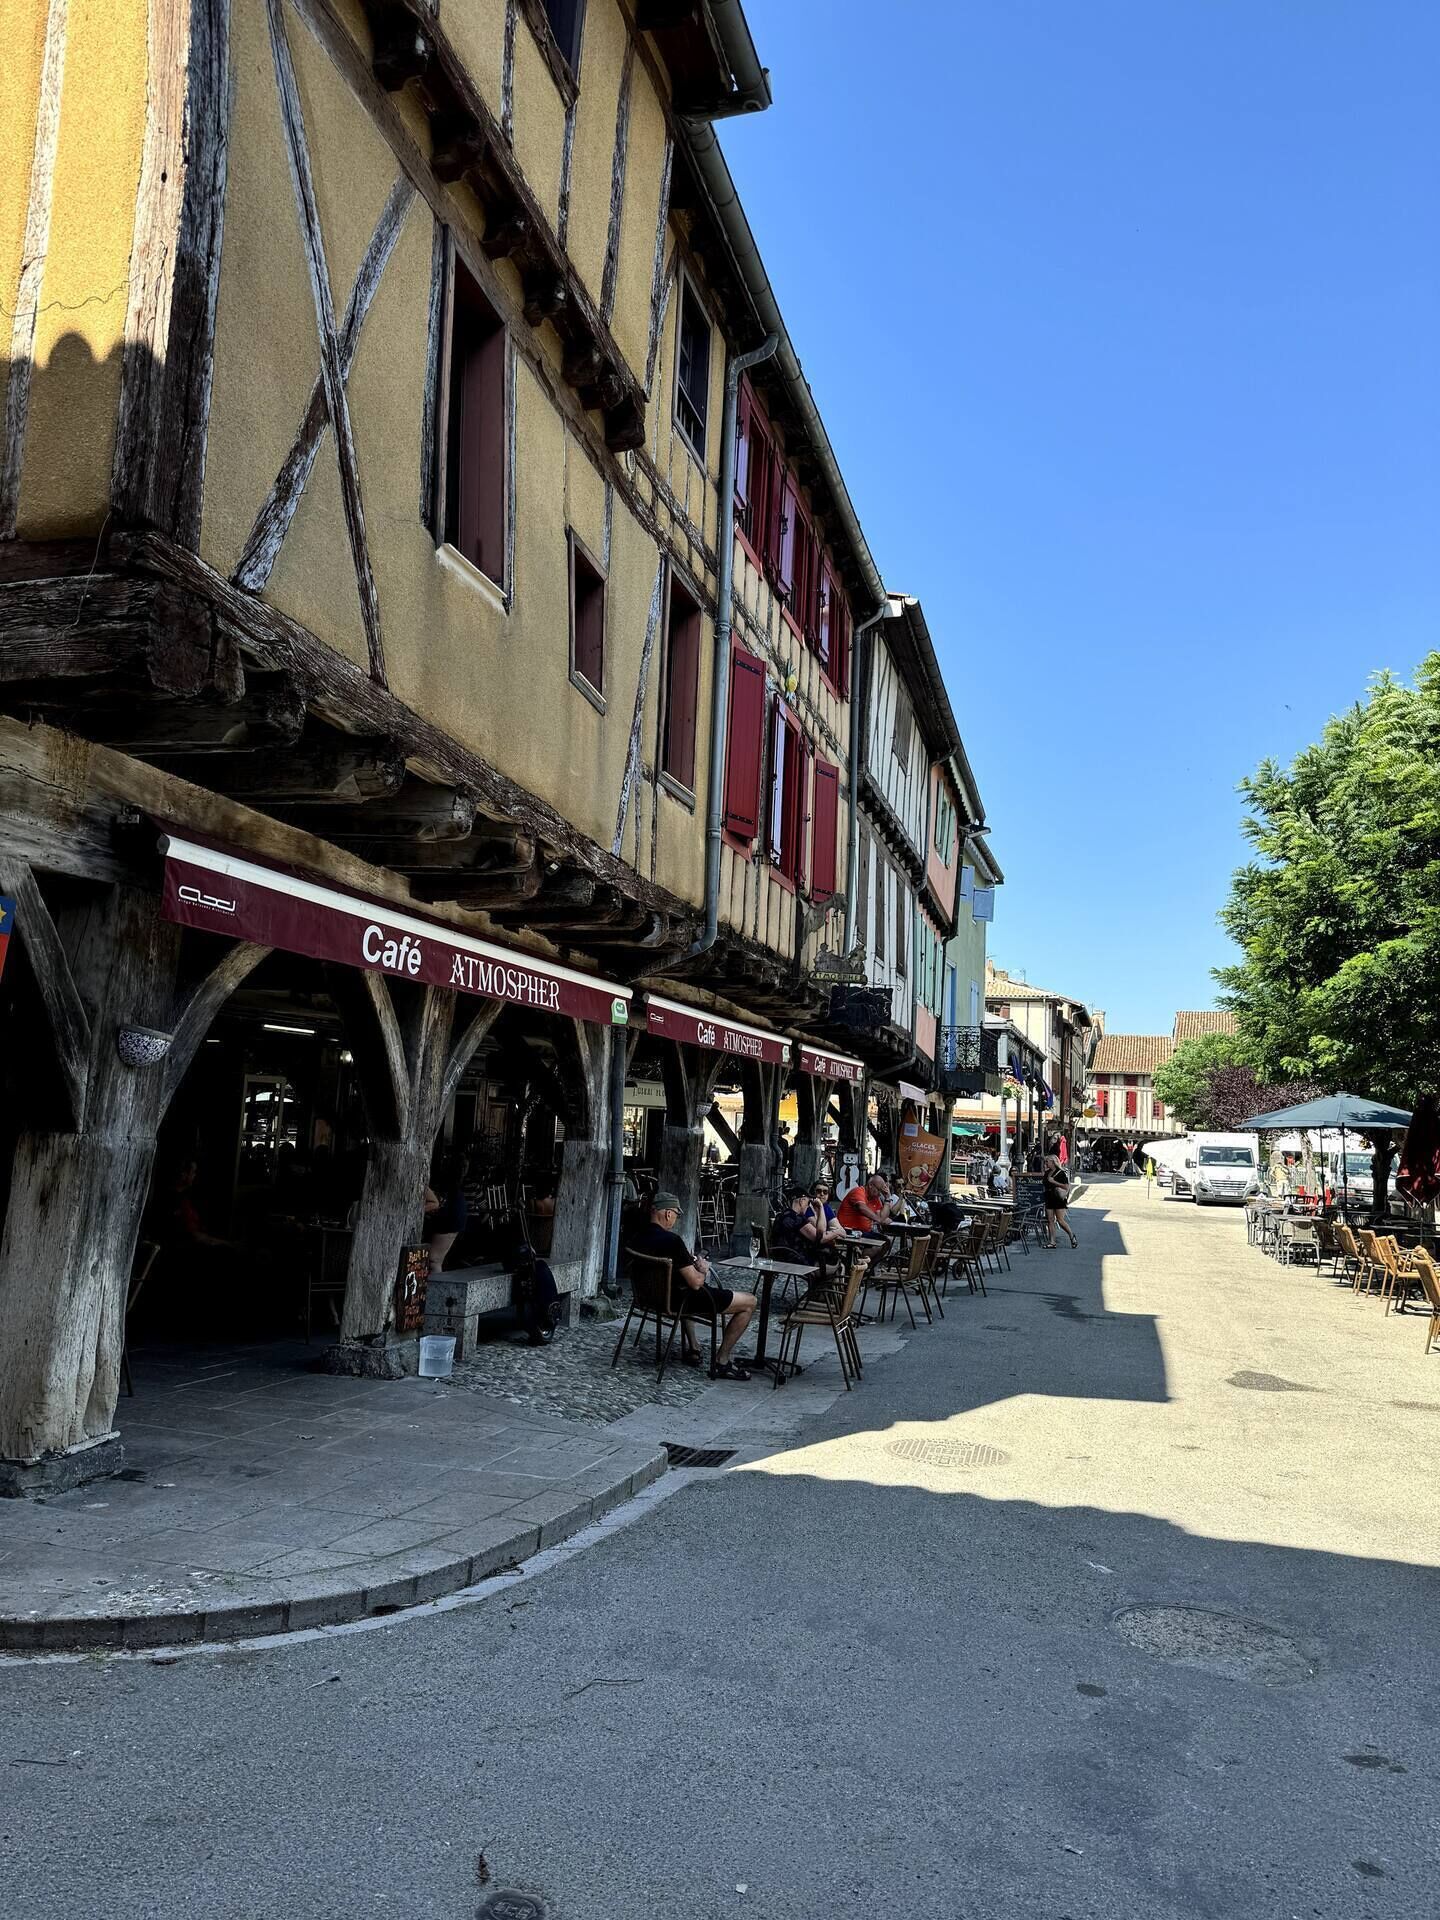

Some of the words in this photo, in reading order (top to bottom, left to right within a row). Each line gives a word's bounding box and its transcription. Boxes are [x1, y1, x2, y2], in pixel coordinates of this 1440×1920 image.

[362, 925, 422, 975] Café
[449, 953, 561, 1011] ATMOSPHER
[697, 1021, 716, 1046] Café
[723, 1030, 763, 1058] ATMOSPHER
[912, 1142, 935, 1150] GLACES
